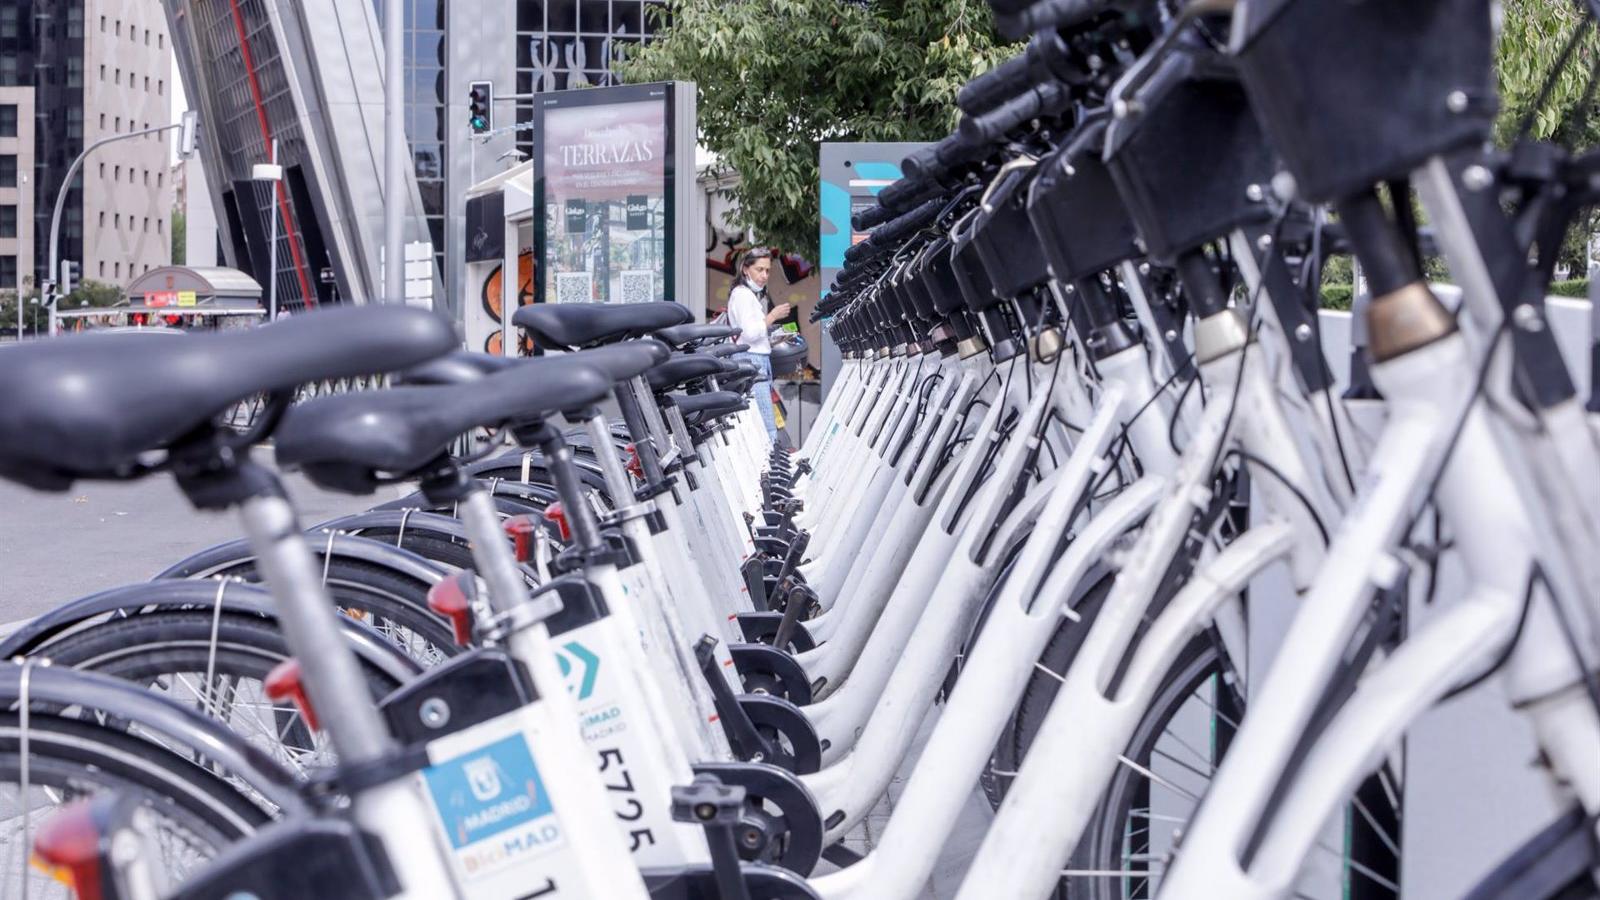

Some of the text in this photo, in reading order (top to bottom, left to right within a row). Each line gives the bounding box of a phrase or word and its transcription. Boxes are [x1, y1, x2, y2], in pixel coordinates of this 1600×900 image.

[560, 139, 653, 166] TERRAZAS
[464, 794, 531, 830] MADRID
[598, 748, 655, 852] 5725
